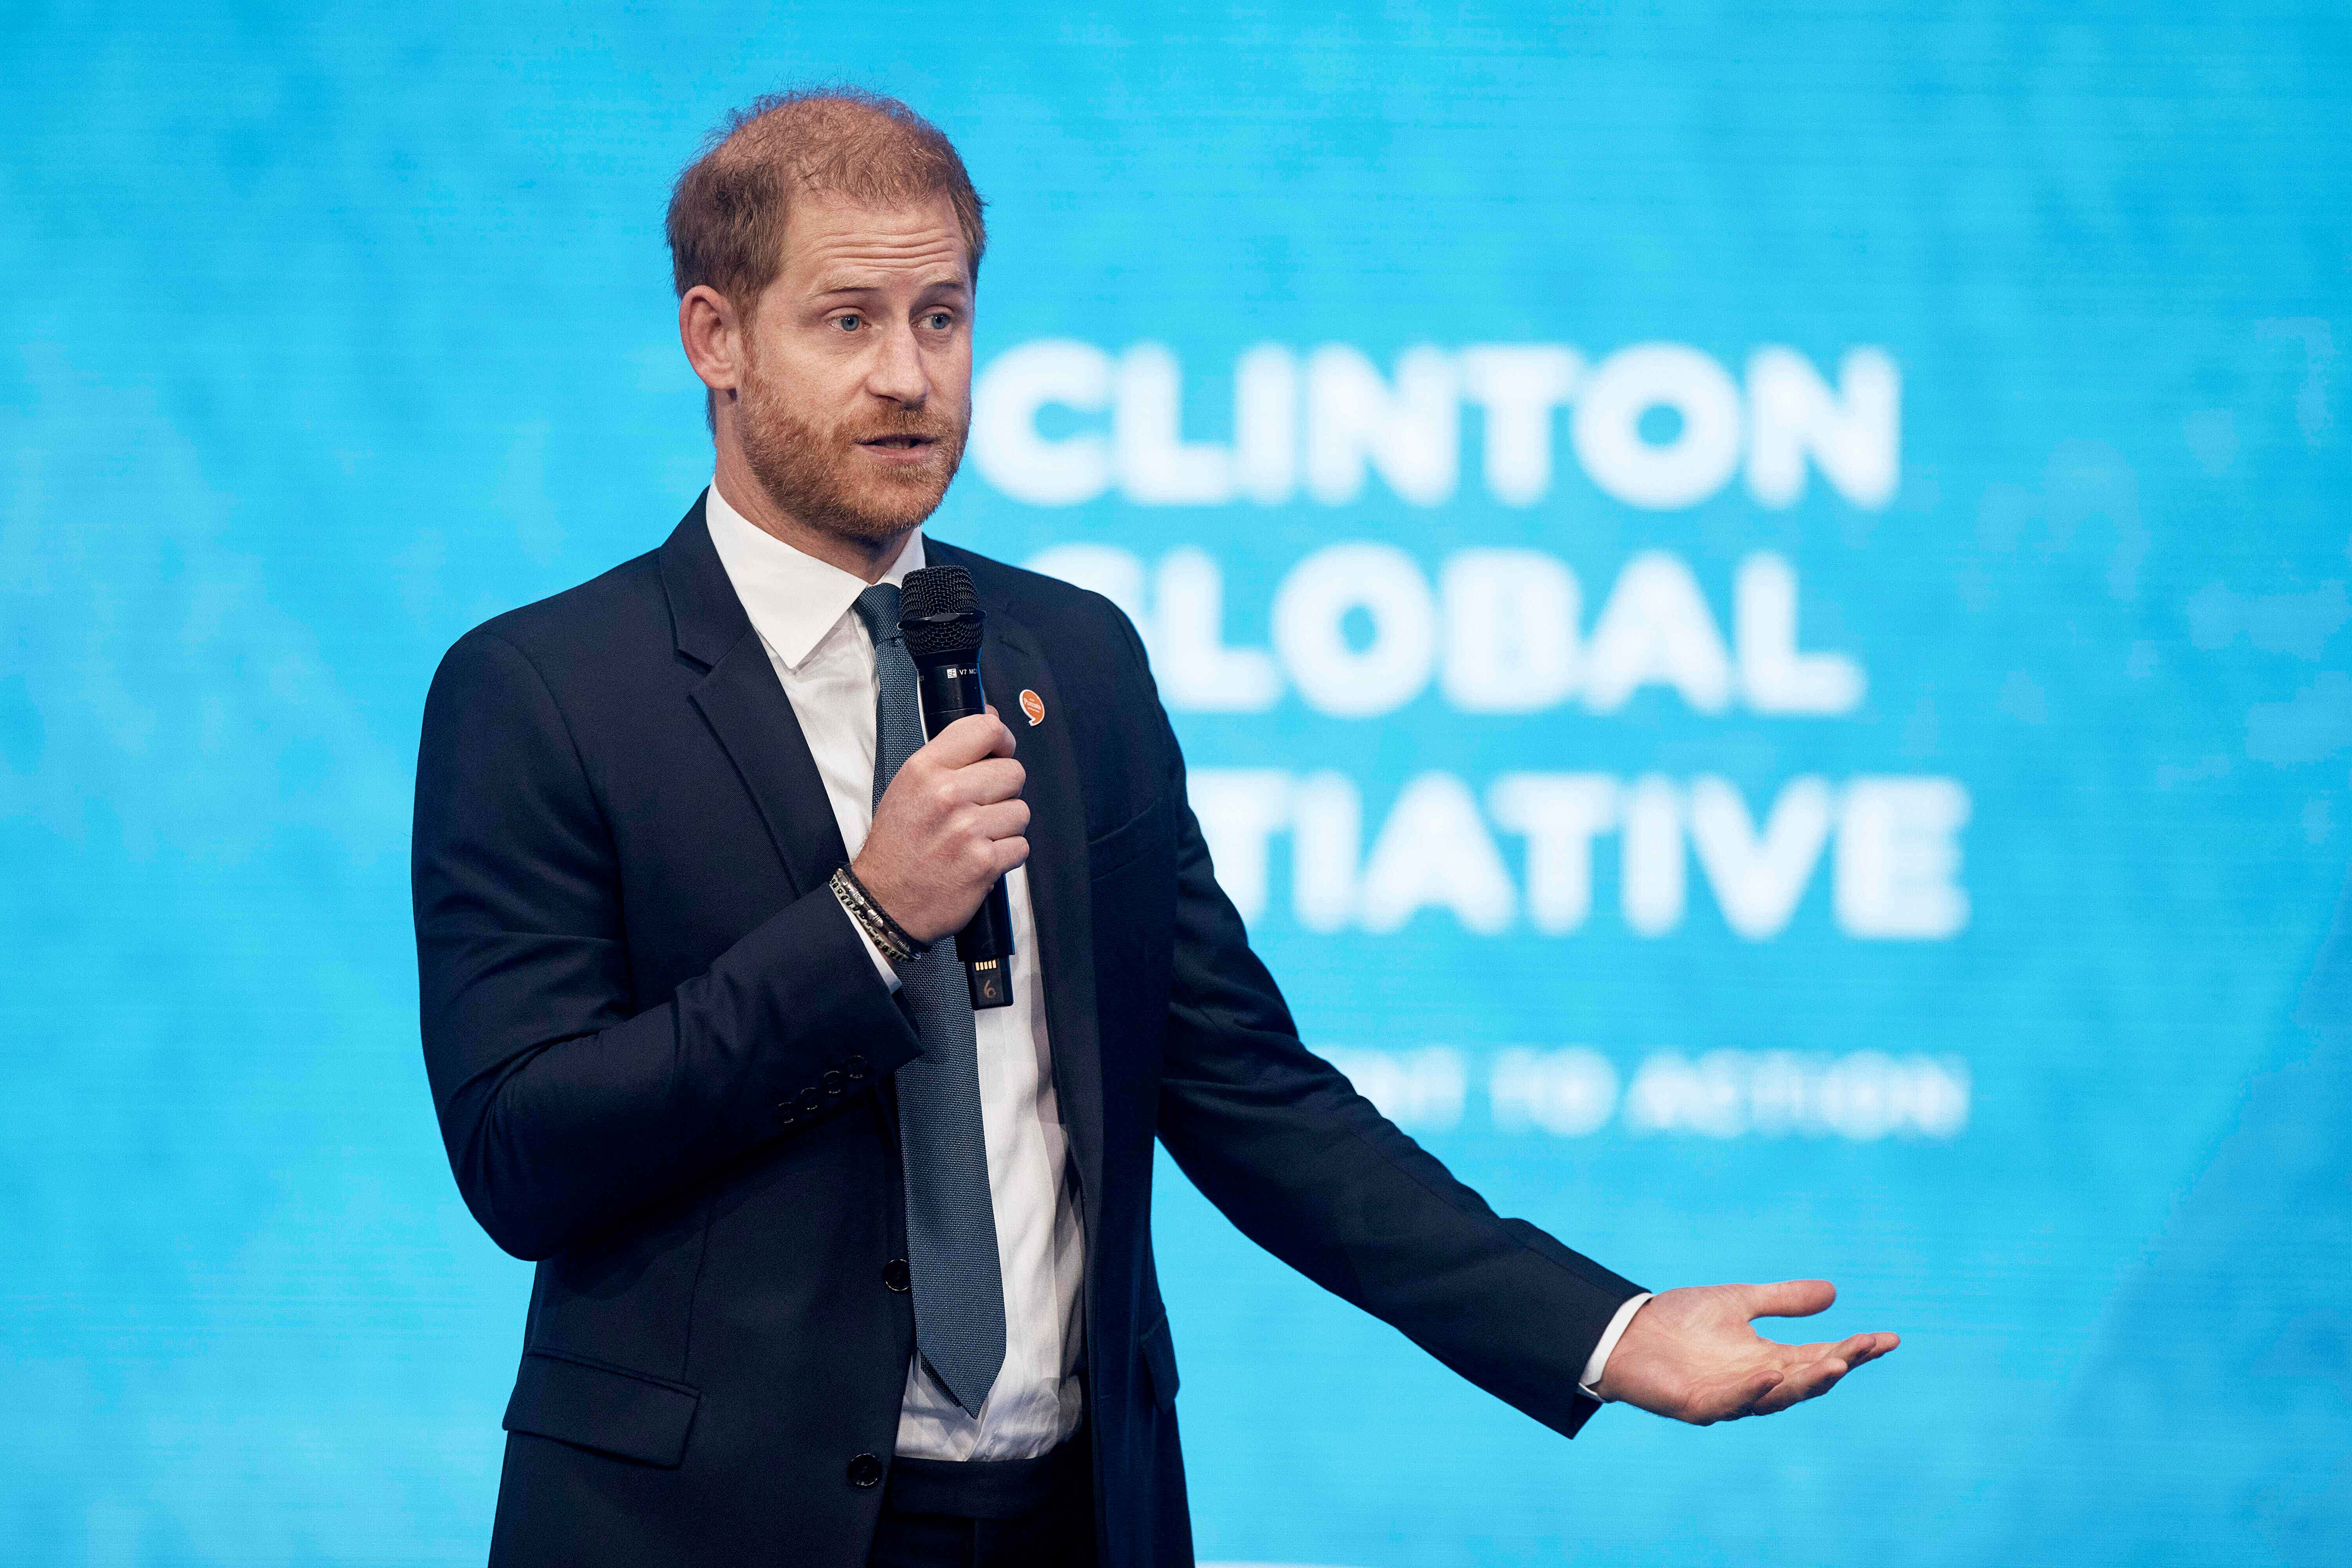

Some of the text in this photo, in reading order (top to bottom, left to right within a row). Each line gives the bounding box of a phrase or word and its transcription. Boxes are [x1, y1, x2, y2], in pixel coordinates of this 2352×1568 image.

[974, 339, 1900, 508] CLINTON
[1187, 768, 1965, 938] TIATIVE
[984, 980, 997, 998] 6
